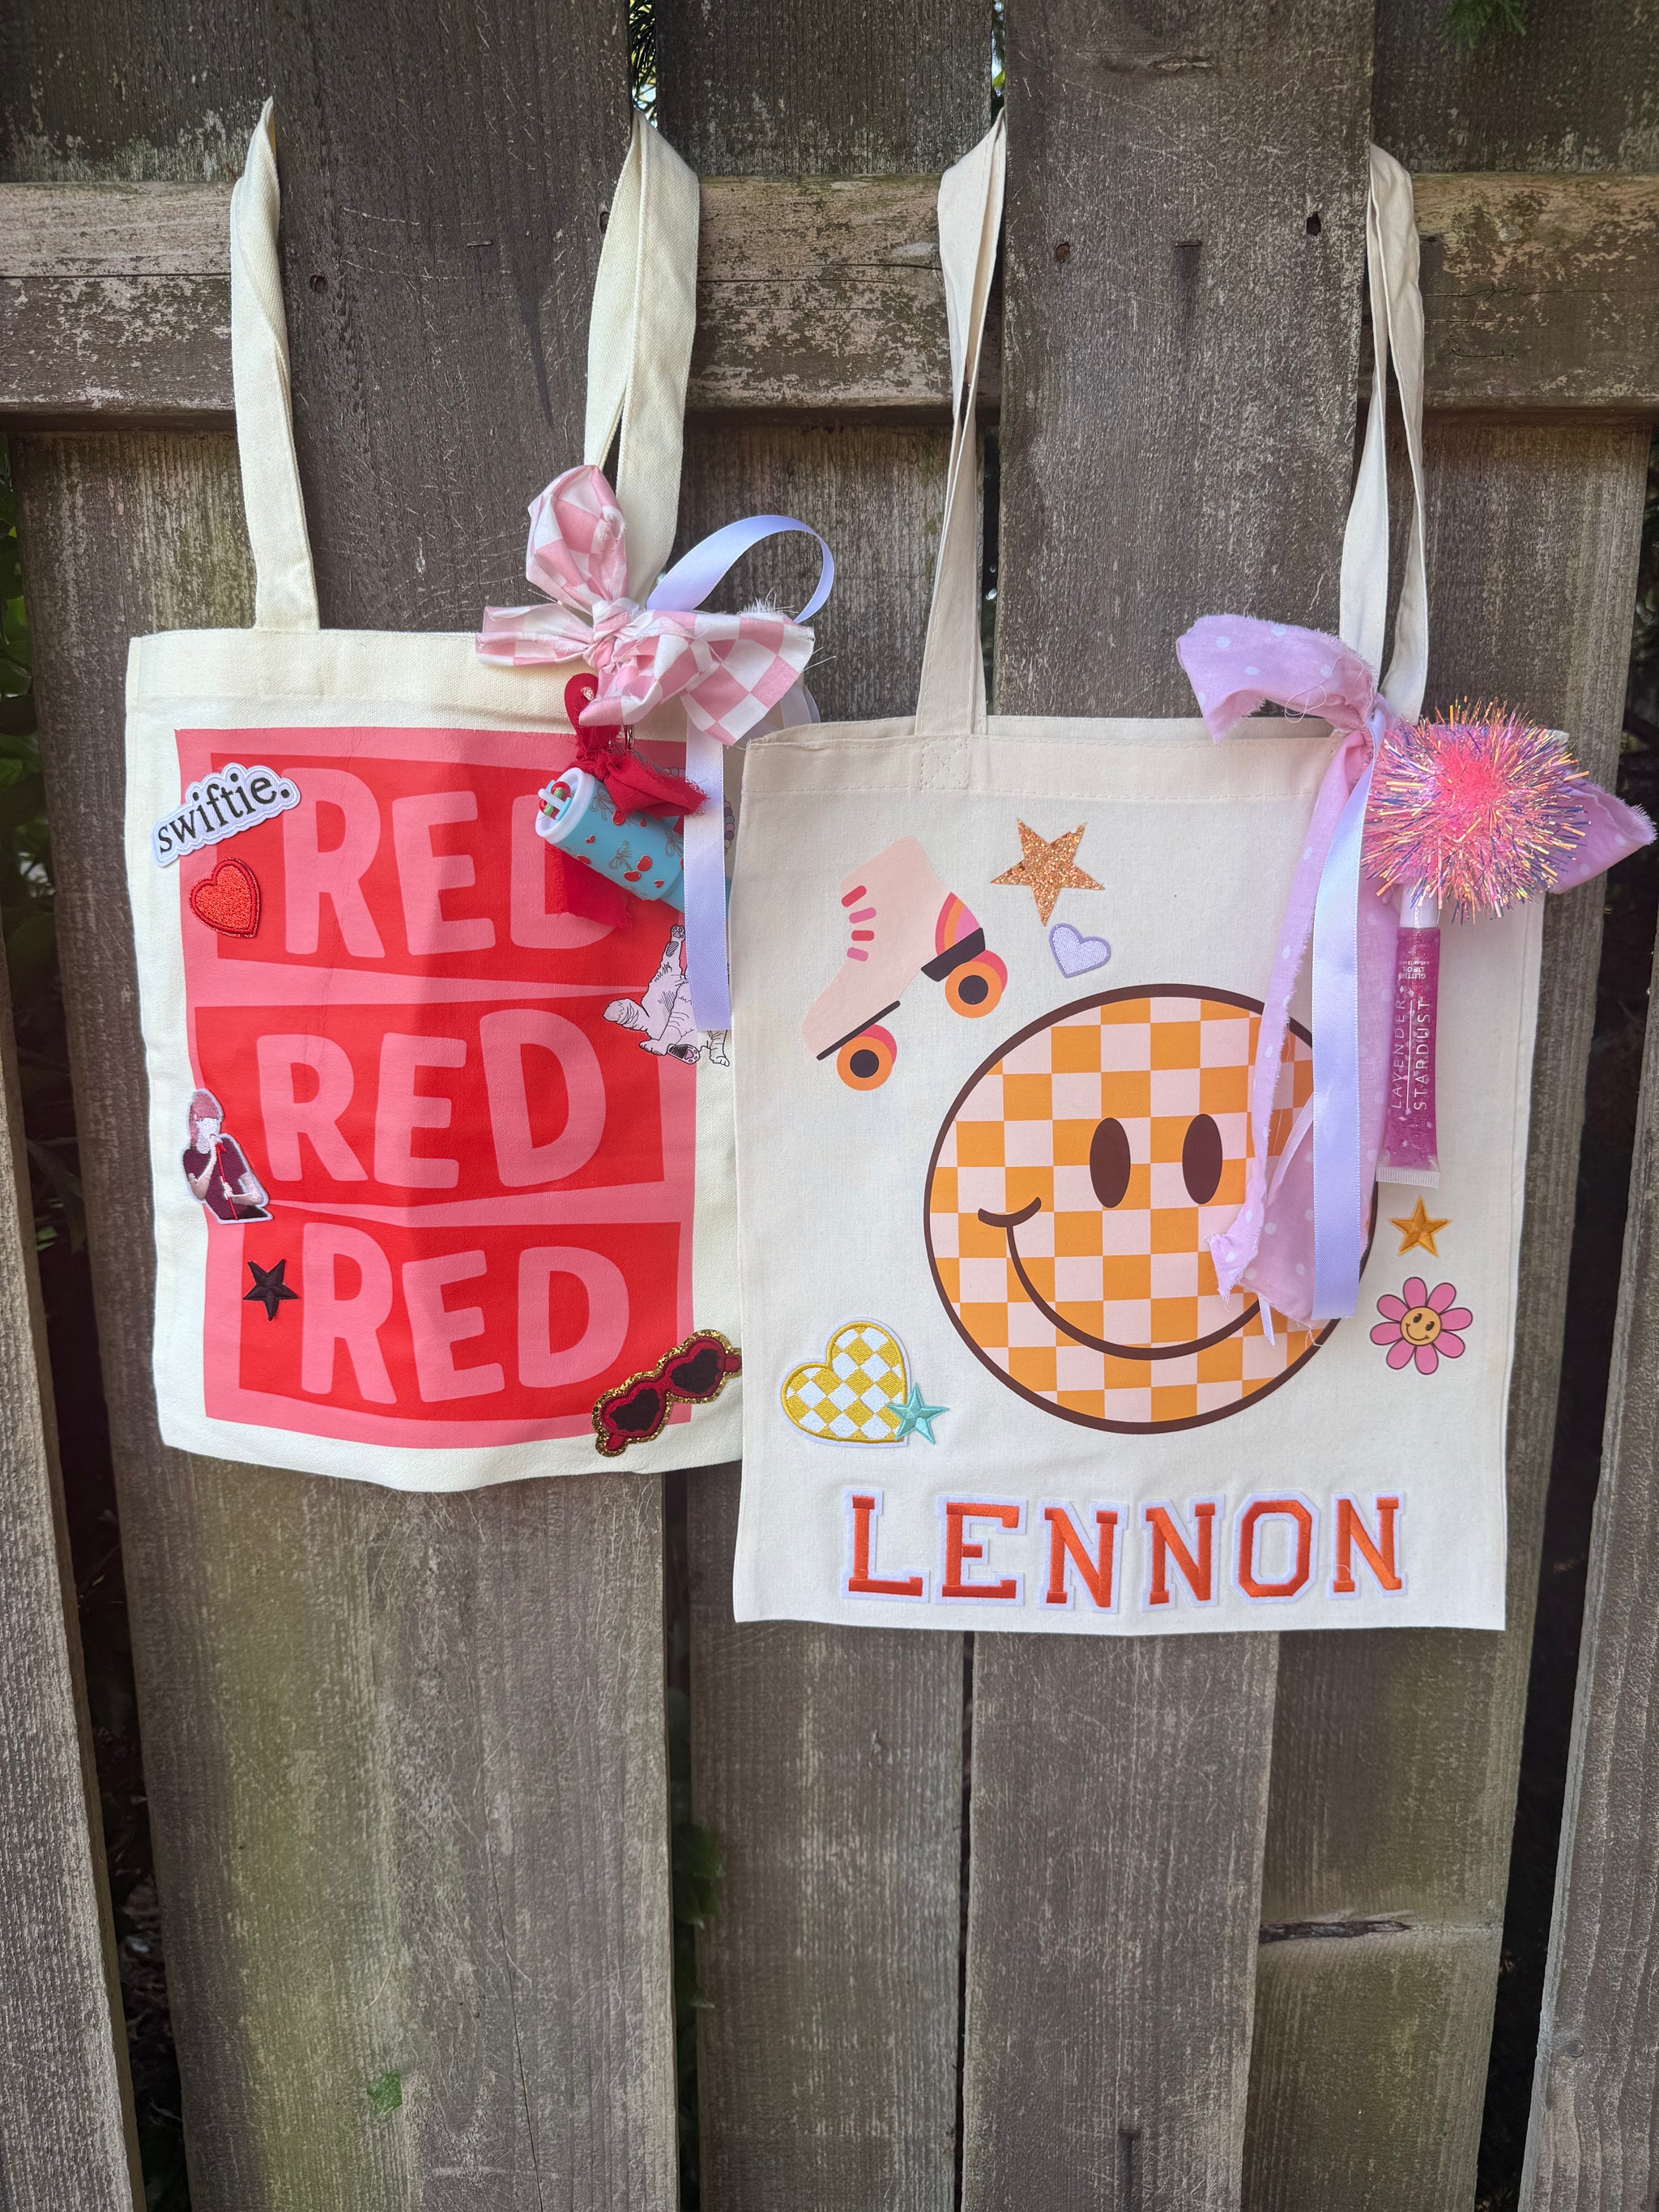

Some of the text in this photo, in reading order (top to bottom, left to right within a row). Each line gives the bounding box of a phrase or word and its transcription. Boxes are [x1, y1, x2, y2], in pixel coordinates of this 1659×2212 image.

[157, 773, 291, 854] swiftie.
[256, 1008, 607, 1189] RED
[1391, 999, 1405, 1110] LAVENDER
[1413, 999, 1431, 1110] STARDUST
[301, 1221, 630, 1405] RED
[847, 1494, 1403, 1609] LENNON
